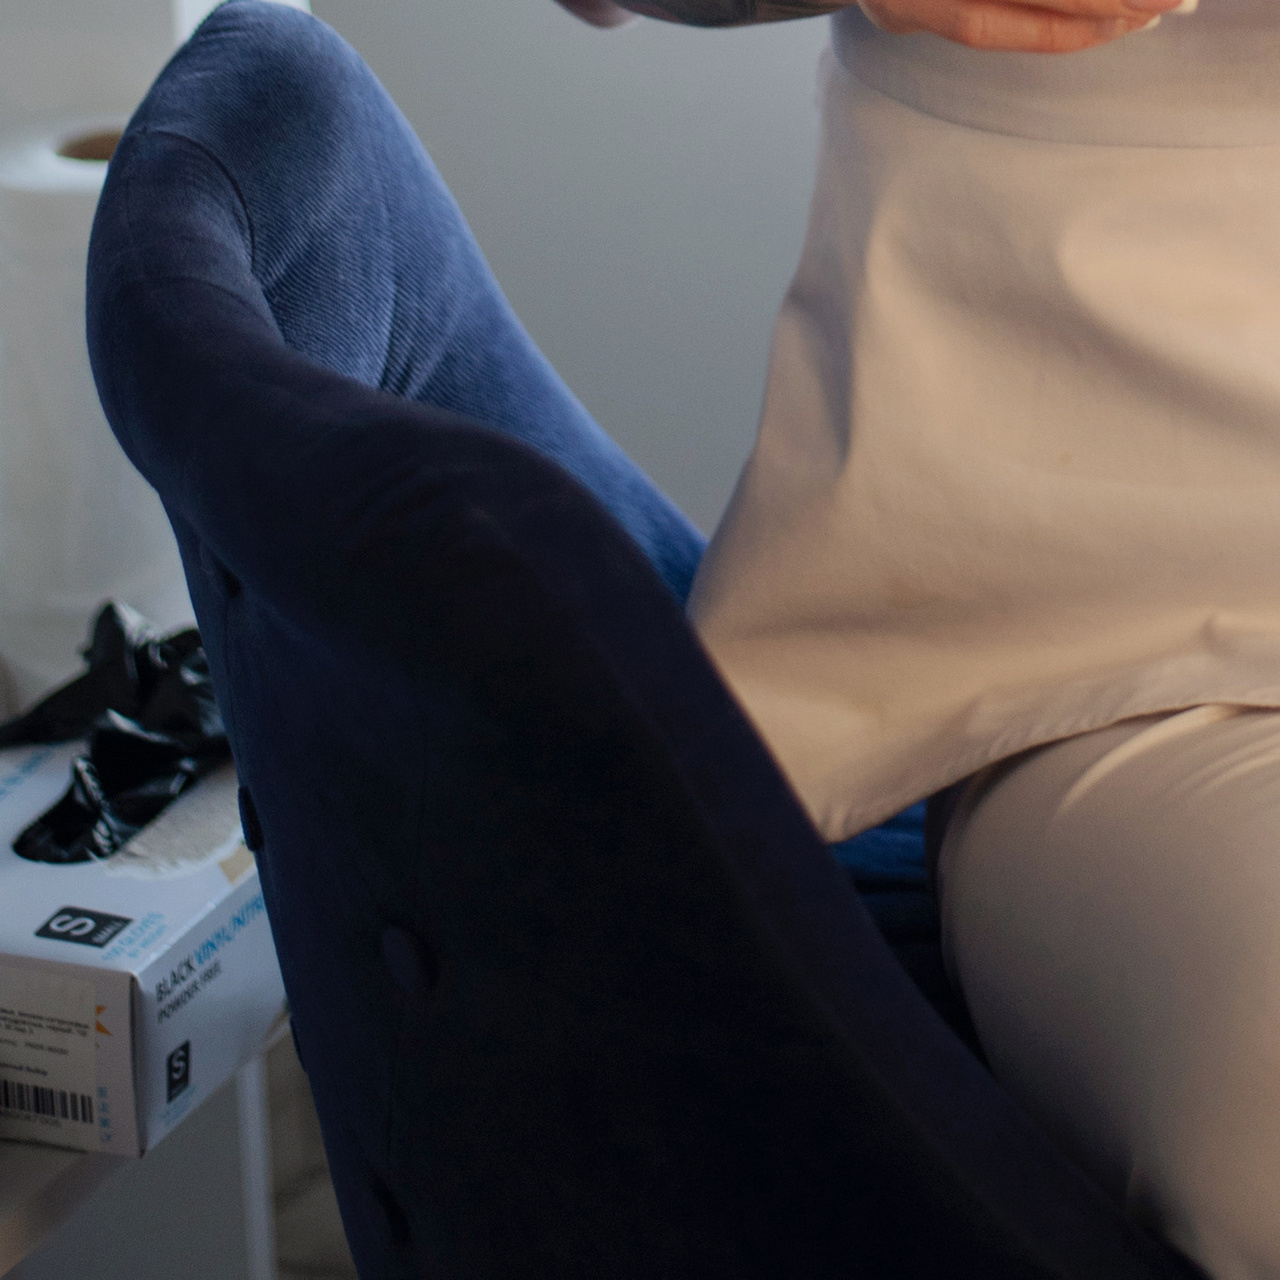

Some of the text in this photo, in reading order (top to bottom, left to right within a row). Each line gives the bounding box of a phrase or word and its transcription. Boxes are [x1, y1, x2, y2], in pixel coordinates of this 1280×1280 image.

[49, 914, 96, 937] S
[155, 954, 196, 1003] BLACK
[171, 1049, 187, 1078] S
